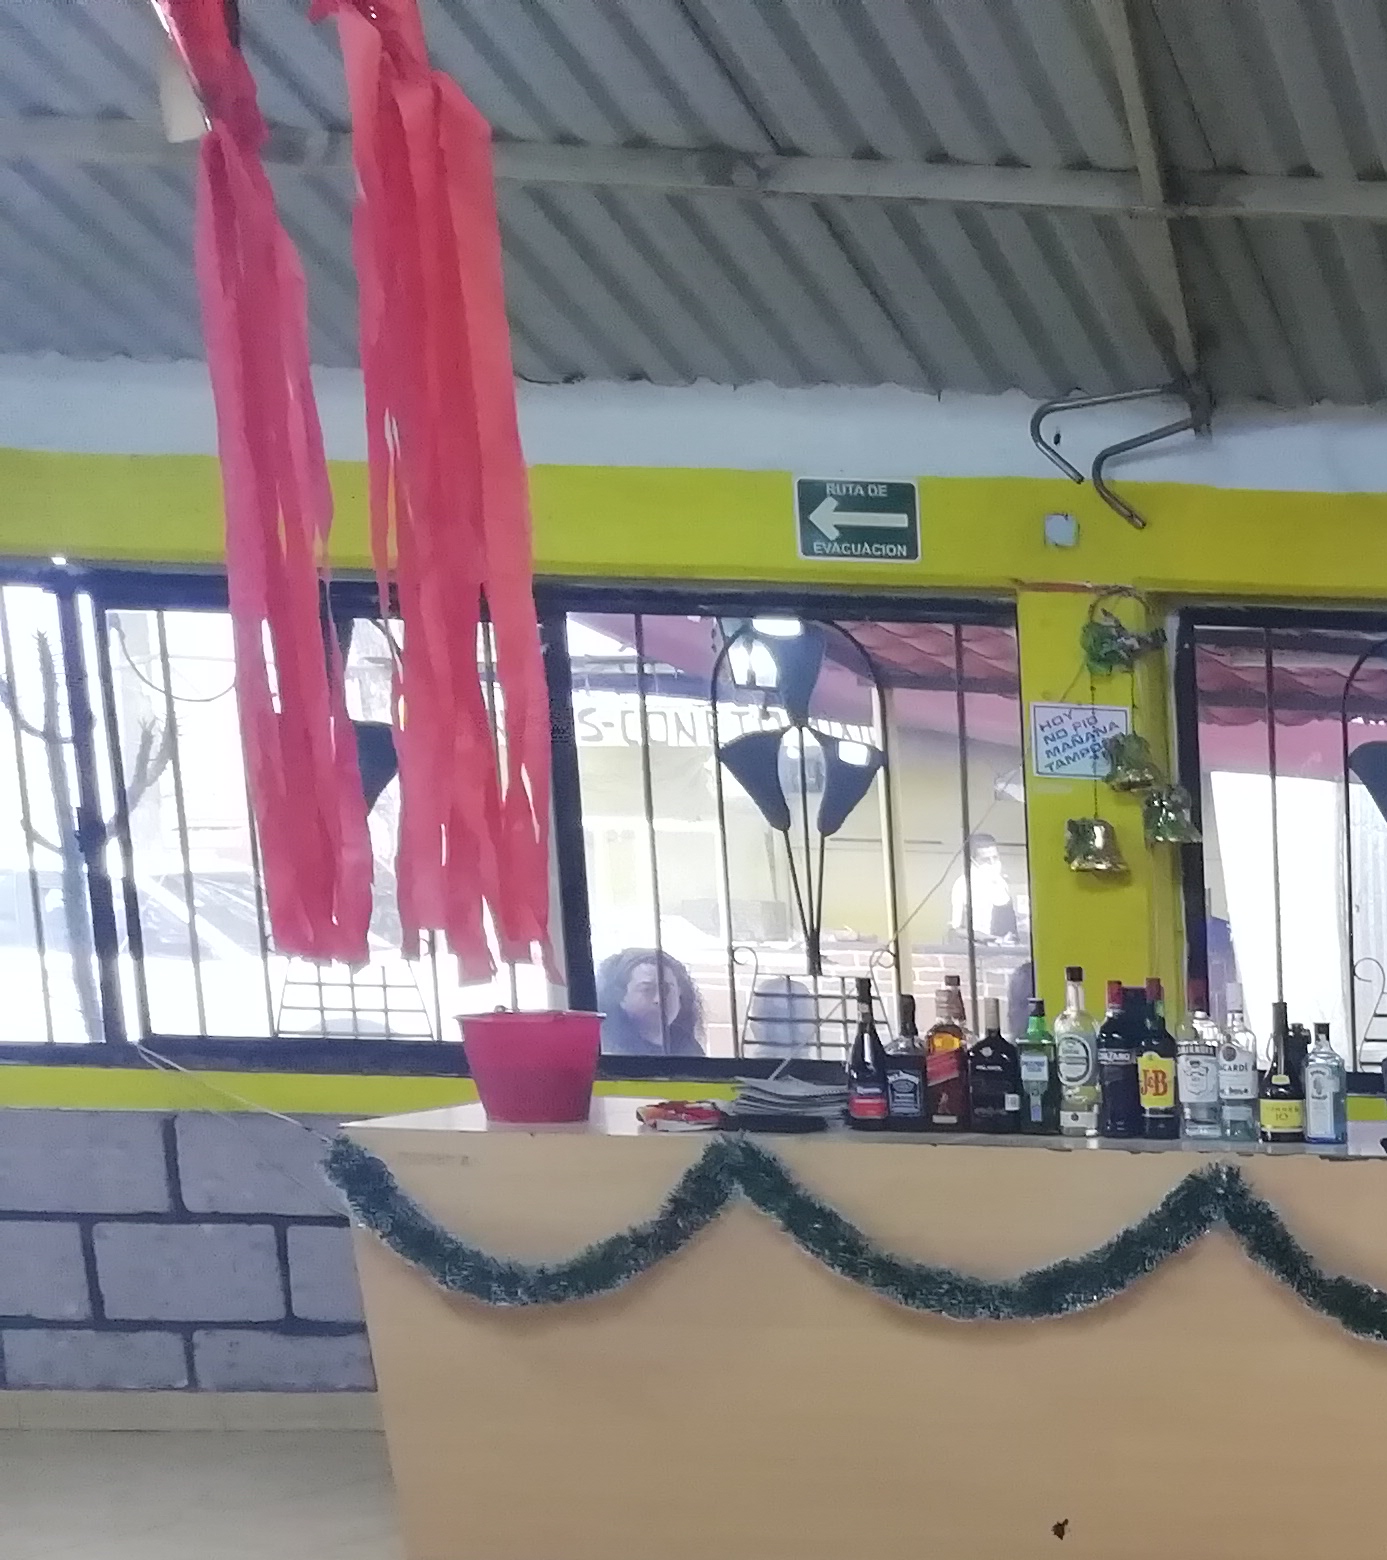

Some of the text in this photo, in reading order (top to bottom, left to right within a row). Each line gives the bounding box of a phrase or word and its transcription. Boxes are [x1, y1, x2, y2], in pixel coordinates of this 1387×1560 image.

[826, 482, 888, 497] RUTA DE
[813, 542, 907, 556] EVACUACION
[1038, 708, 1073, 732] HOY
[1043, 727, 1069, 746] NO
[1044, 741, 1104, 773] TAMPO
[1141, 1069, 1168, 1097] J&B
